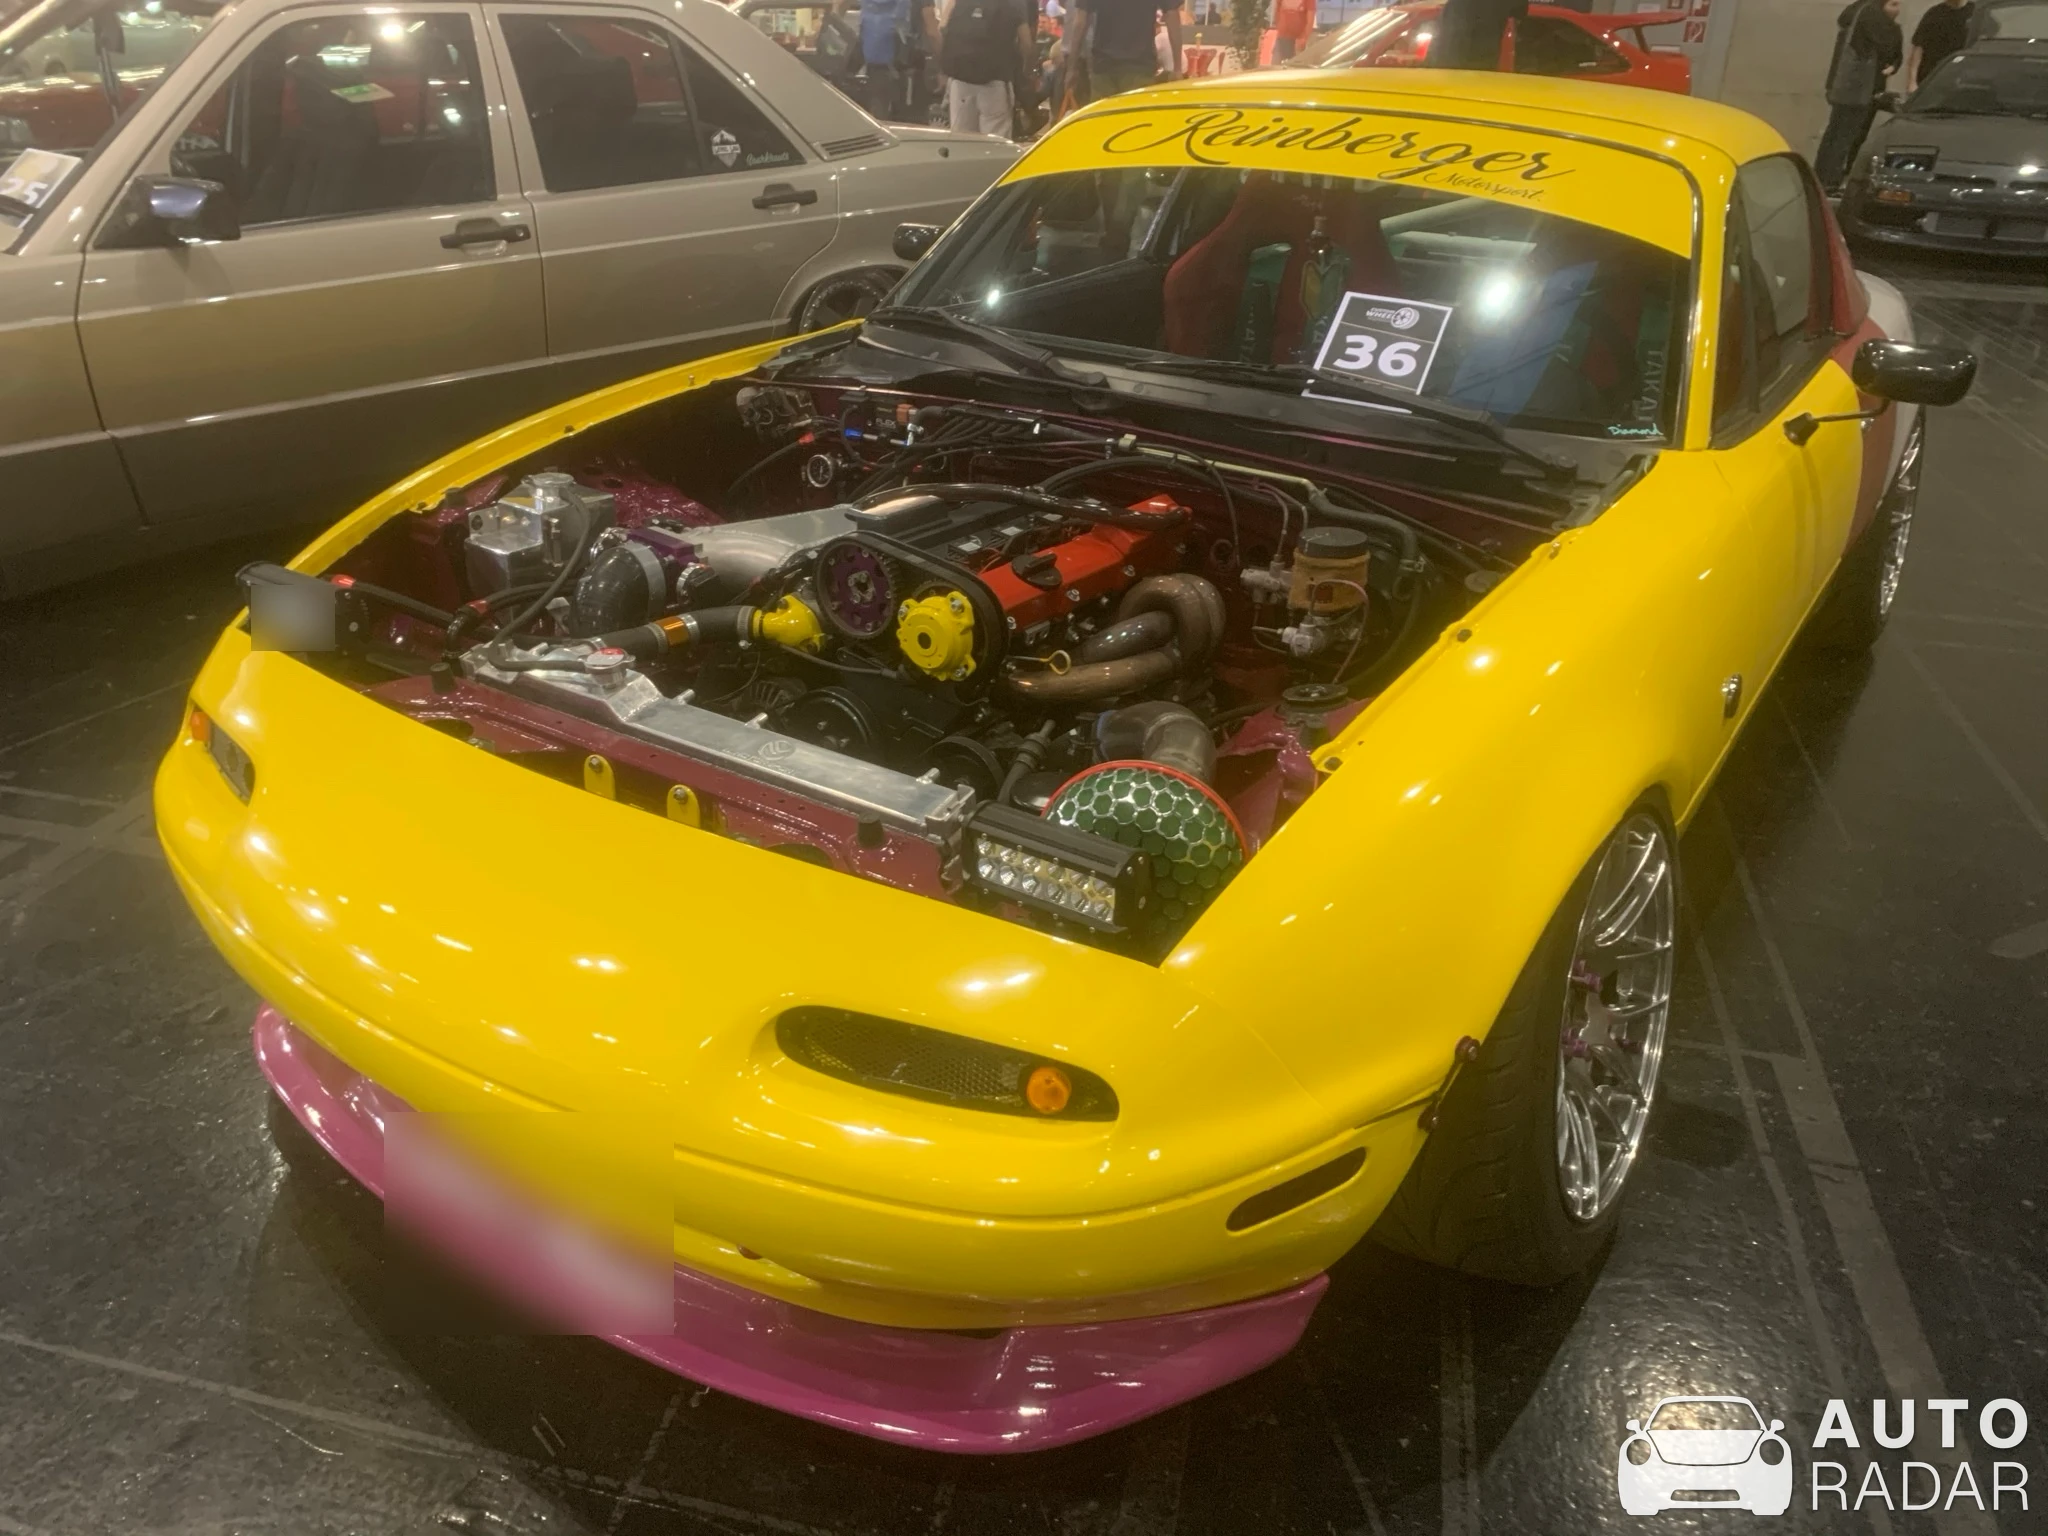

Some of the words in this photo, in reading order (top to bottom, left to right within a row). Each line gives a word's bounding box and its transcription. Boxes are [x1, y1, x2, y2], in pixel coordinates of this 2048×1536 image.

[1102, 110, 1576, 181] Reinberger
[0, 178, 48, 205] 25
[1333, 335, 1421, 377] 36
